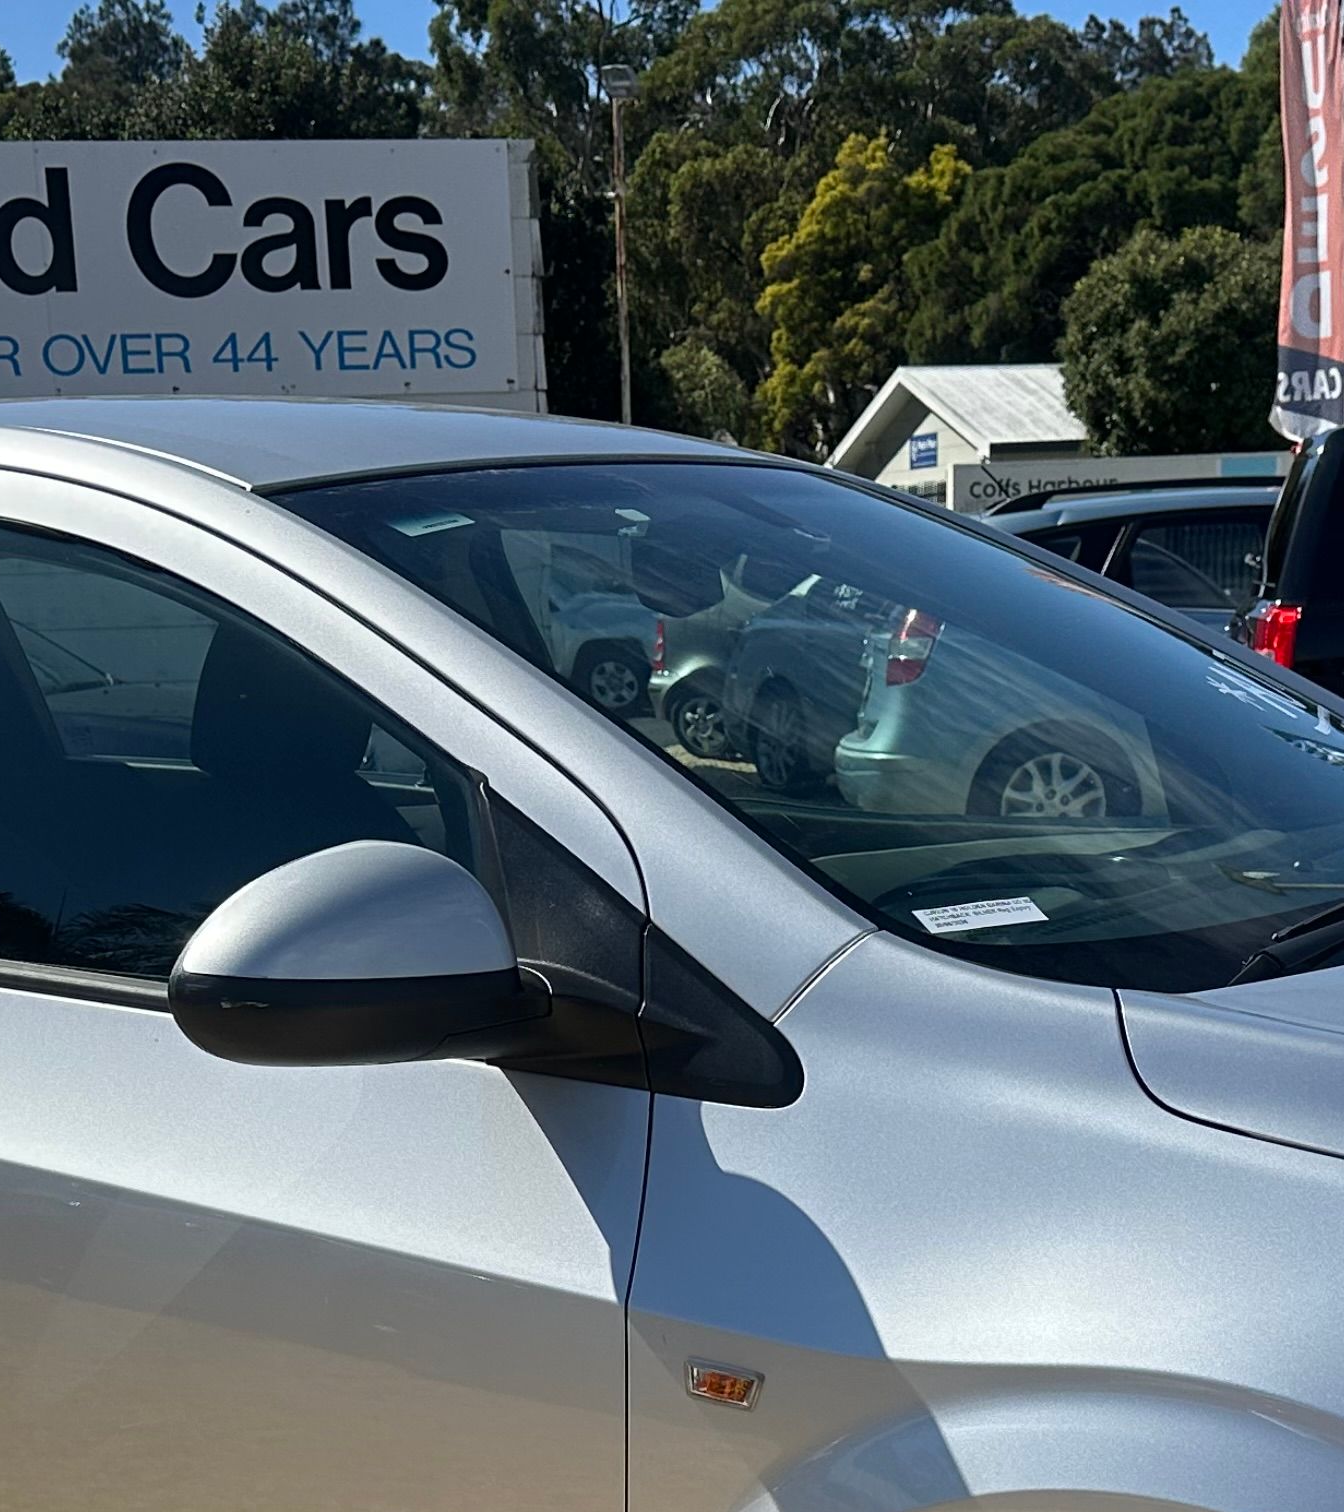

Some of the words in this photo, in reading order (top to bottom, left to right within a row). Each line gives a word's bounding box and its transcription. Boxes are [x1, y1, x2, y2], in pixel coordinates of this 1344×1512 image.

[126, 161, 449, 298] Cars
[42, 332, 193, 377] OVER
[212, 331, 279, 374] 44
[300, 327, 478, 372] YEARS
